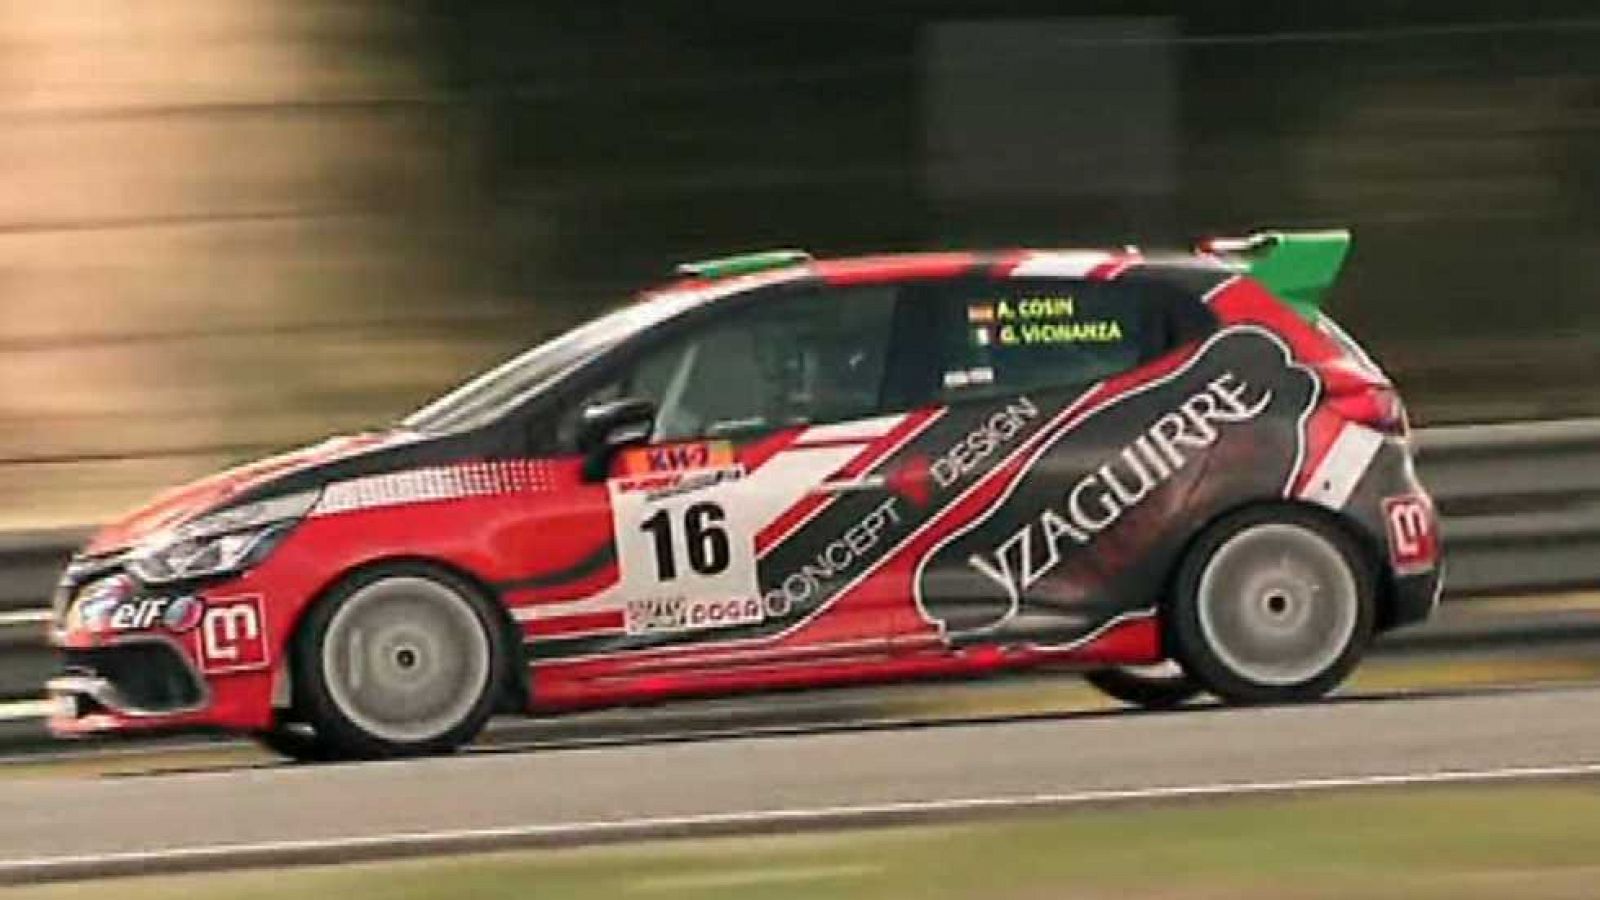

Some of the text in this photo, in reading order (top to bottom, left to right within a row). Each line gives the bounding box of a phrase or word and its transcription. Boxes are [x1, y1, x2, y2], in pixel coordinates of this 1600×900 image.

[997, 300, 1016, 319] A.
[930, 396, 1039, 489] DESIGN
[966, 371, 1273, 622] YZAGUIRRE
[639, 500, 731, 582] 16
